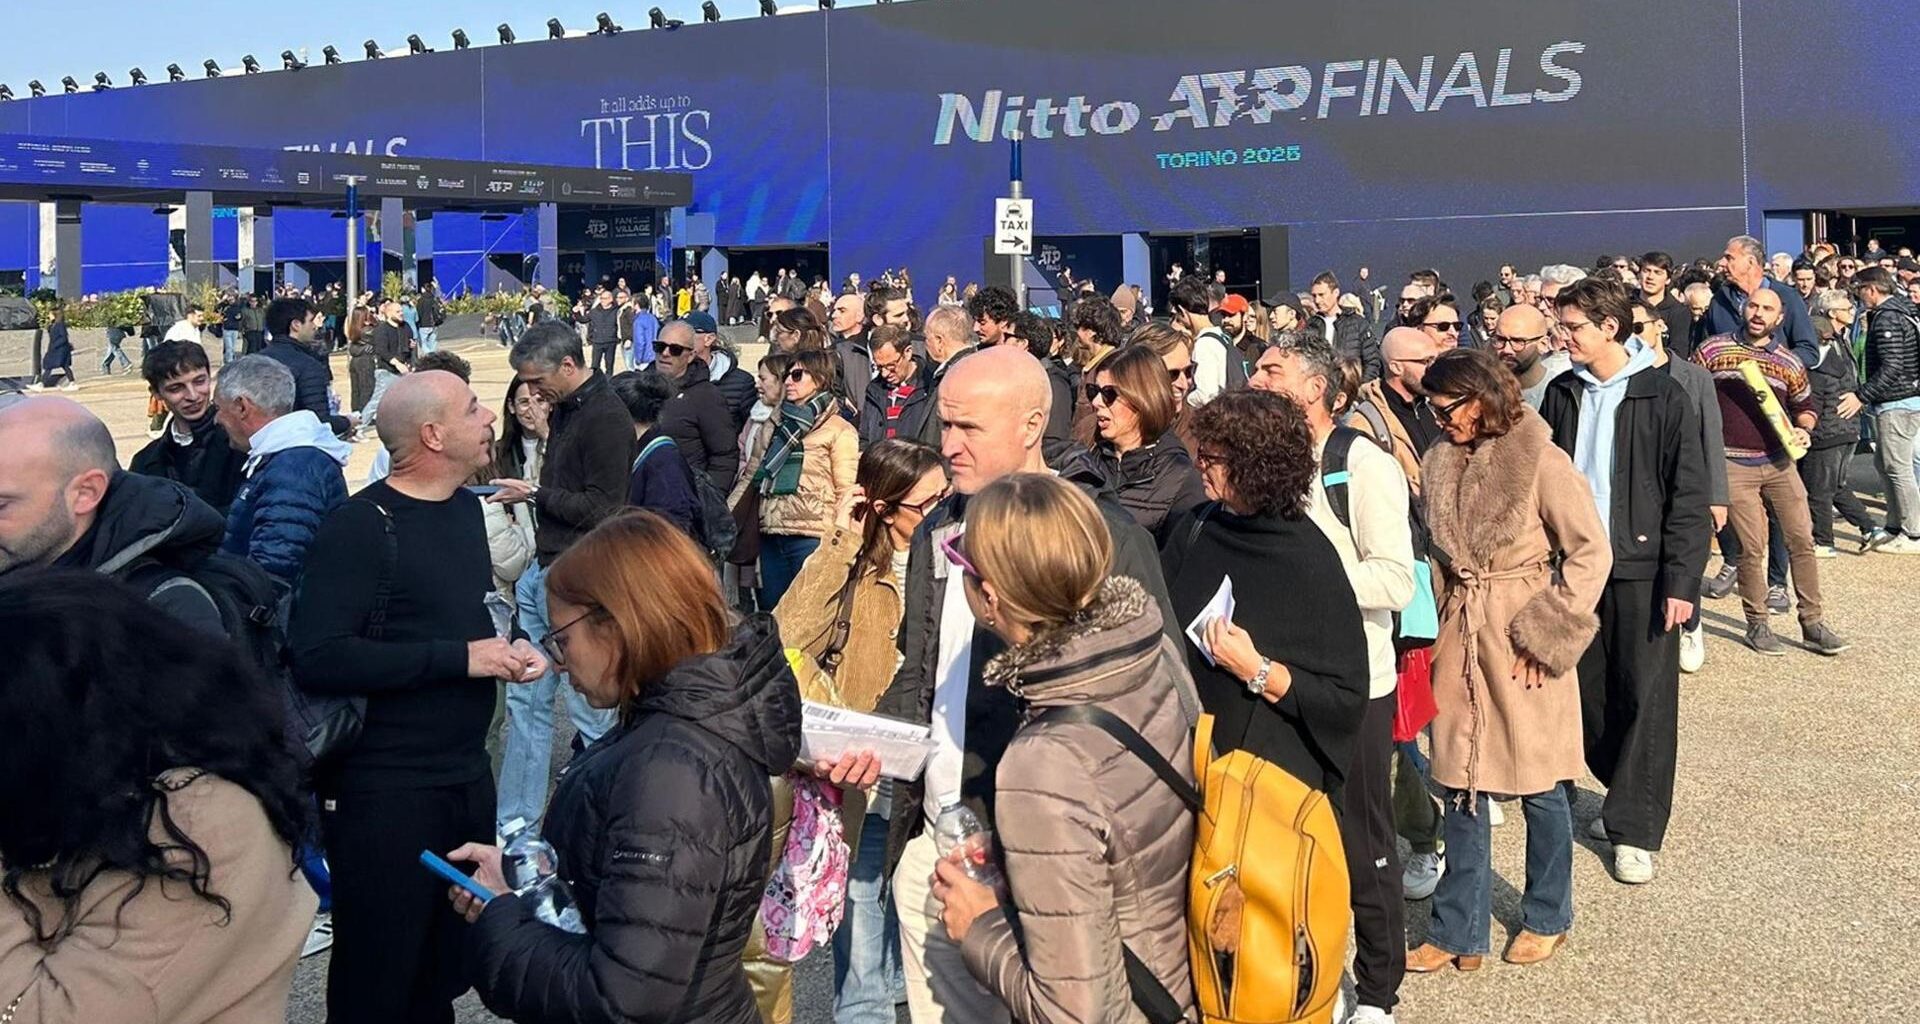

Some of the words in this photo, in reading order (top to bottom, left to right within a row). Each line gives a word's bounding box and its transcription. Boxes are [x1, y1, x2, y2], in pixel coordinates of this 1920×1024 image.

[600, 99, 609, 114] It
[611, 97, 626, 113] all
[628, 95, 657, 112] adds
[660, 97, 676, 112] up
[678, 95, 691, 108] to
[934, 90, 1140, 145] Nitto
[1151, 65, 1312, 132] ATP
[1317, 40, 1586, 120] FINALS
[580, 110, 713, 171] THIS
[1156, 149, 1238, 169] TORINO
[1243, 145, 1301, 164] 2025
[1001, 220, 1028, 231] TAXI
